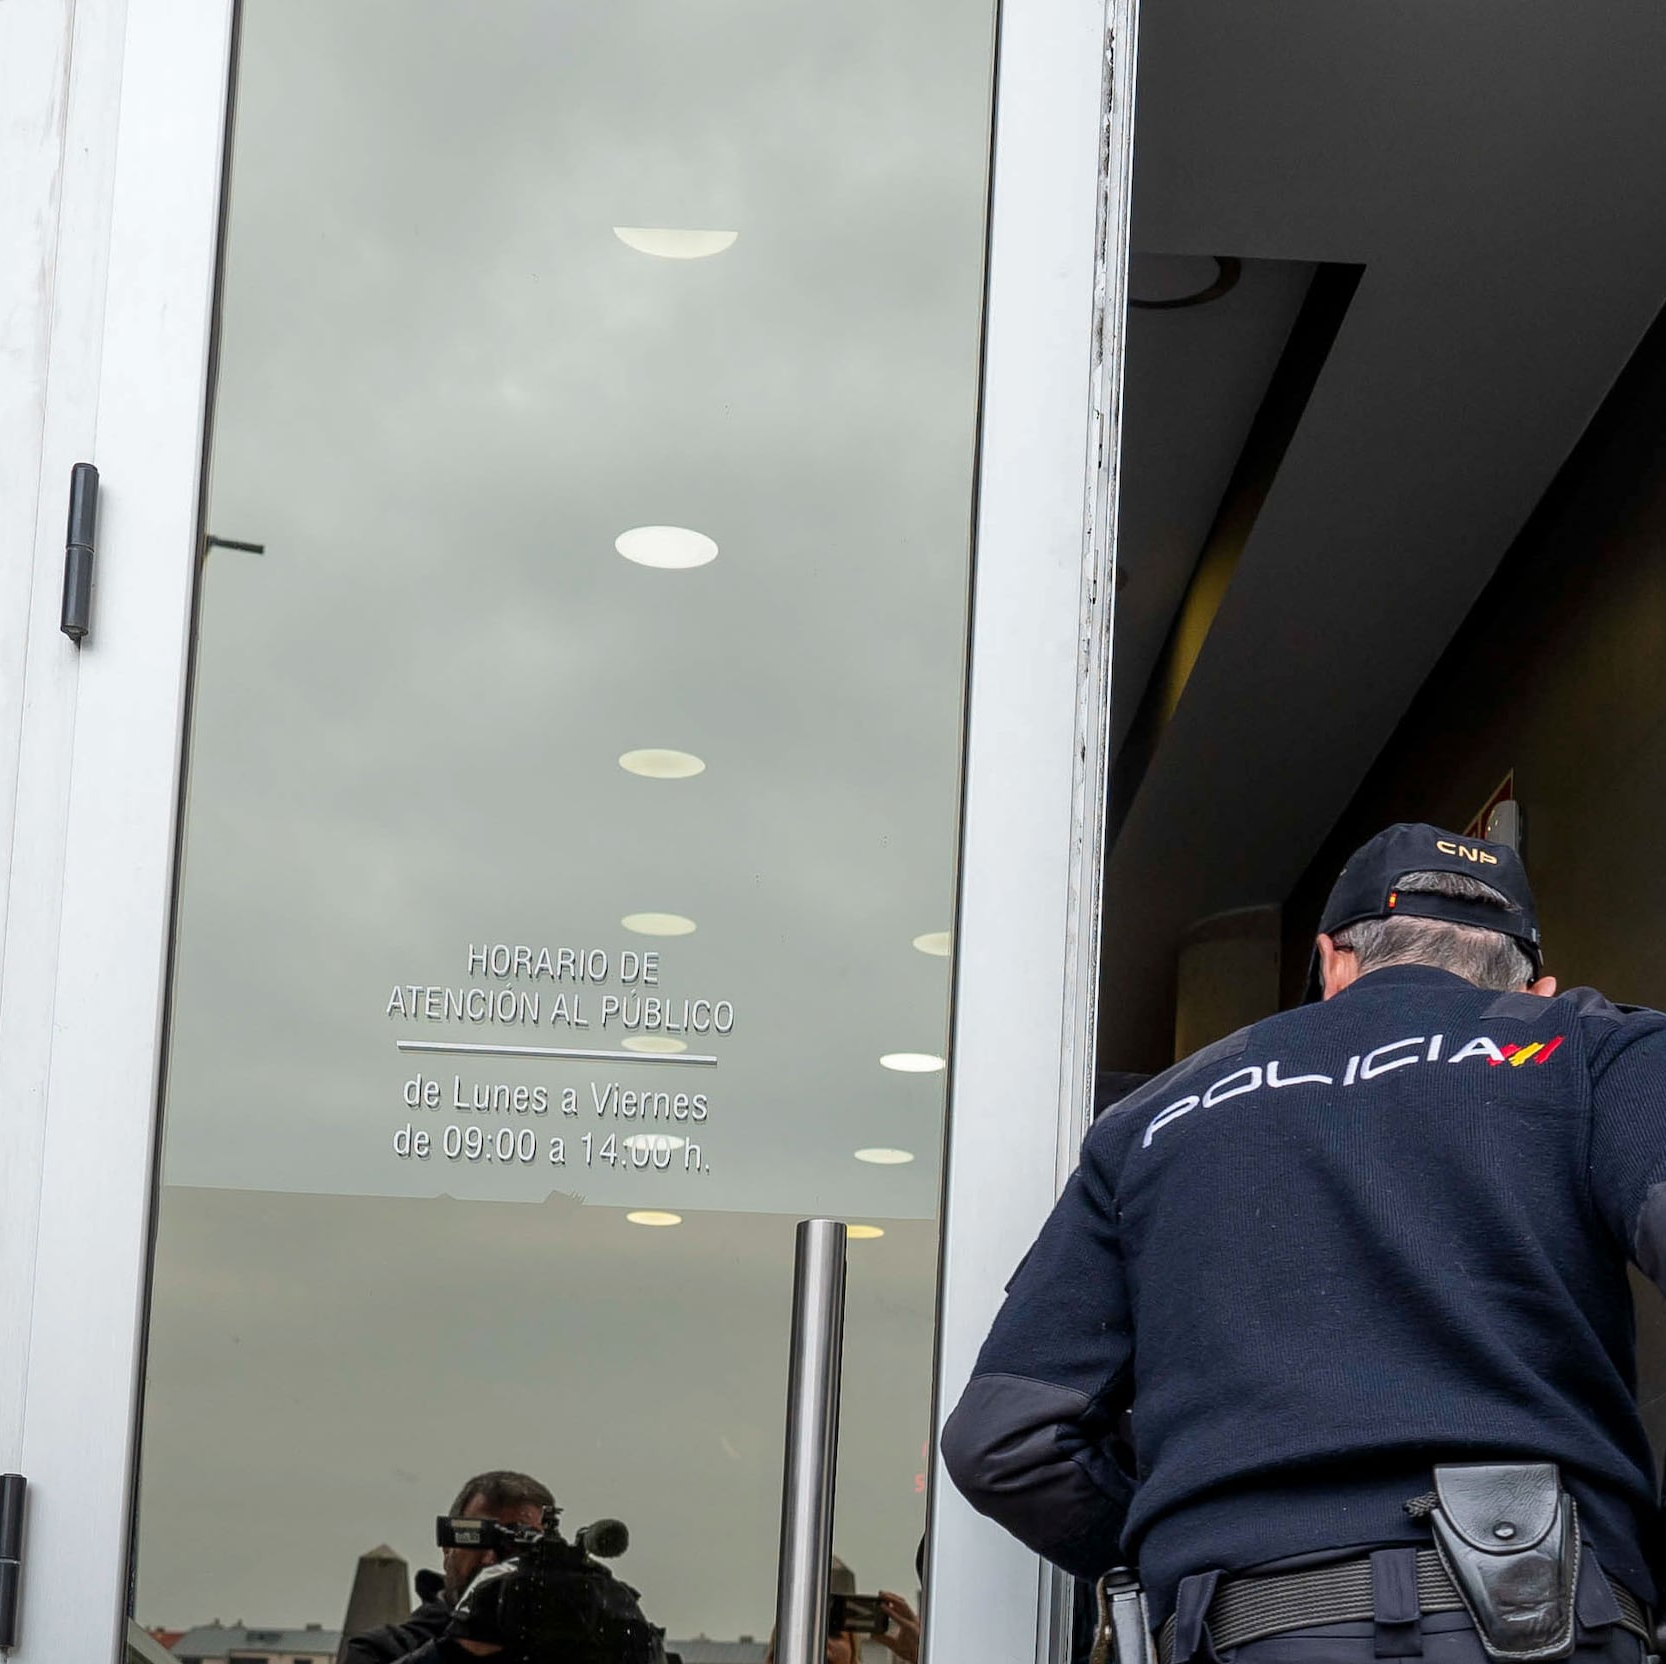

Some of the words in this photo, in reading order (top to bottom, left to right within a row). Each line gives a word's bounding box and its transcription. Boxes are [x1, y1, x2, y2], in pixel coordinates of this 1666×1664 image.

[1436, 840, 1499, 866] CNP
[467, 943, 609, 983] HORARIO
[619, 951, 661, 985] DE
[386, 982, 540, 1027] ATENCIÓN
[550, 992, 590, 1029] AL
[600, 988, 735, 1034] PÚBLICO
[402, 1072, 441, 1111] de
[452, 1074, 548, 1115] Lunes
[560, 1086, 579, 1117] a
[590, 1081, 708, 1121] Viernes
[1142, 1034, 1505, 1148] POLICIA
[392, 1123, 431, 1159] de
[442, 1125, 537, 1163] 09:00
[548, 1135, 567, 1165] a
[683, 1137, 711, 1174] h.
